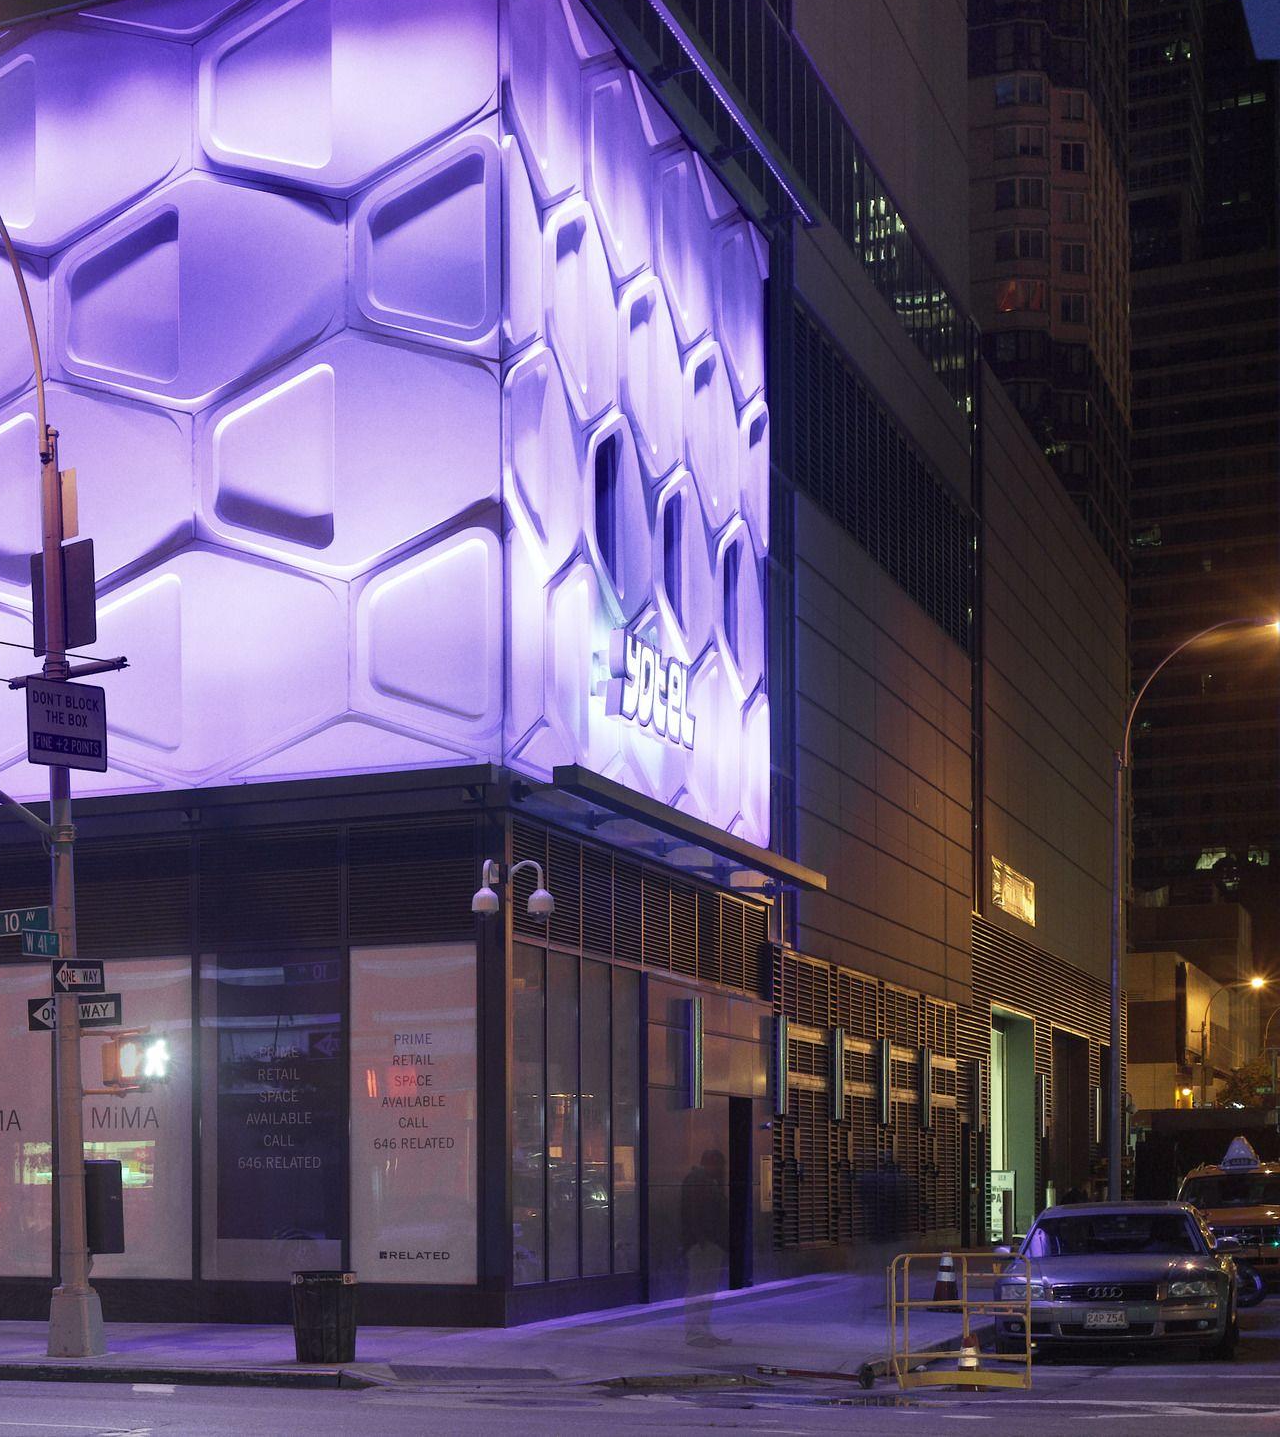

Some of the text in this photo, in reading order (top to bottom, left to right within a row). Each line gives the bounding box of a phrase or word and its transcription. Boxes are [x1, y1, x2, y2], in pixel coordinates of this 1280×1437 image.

[65, 696, 99, 712] BLOCK
[46, 709, 88, 728] THE BOX
[36, 735, 53, 749] FINE
[71, 739, 100, 755] POINTS
[4, 911, 35, 932] 10 AV
[26, 933, 34, 952] W
[38, 933, 48, 953] 41
[60, 970, 98, 983] ONE WAY
[42, 1004, 109, 1021] ON WAY
[394, 1033, 433, 1045] PRIME
[259, 1046, 299, 1058] PRIME
[392, 1054, 435, 1066] RETAIL
[257, 1068, 300, 1081] RETAIL
[394, 1075, 433, 1087] SPACE
[259, 1090, 299, 1102] SPACE
[381, 1095, 446, 1108] AVAILABLE
[91, 1106, 159, 1129] MiMA
[246, 1112, 312, 1125] AVAILABLE
[398, 1117, 429, 1129] CALL
[263, 1135, 294, 1147] CALL
[373, 1137, 455, 1150] 646.RELATED
[238, 1157, 321, 1169] 646.RELATED
[389, 1251, 451, 1260] RELATED
